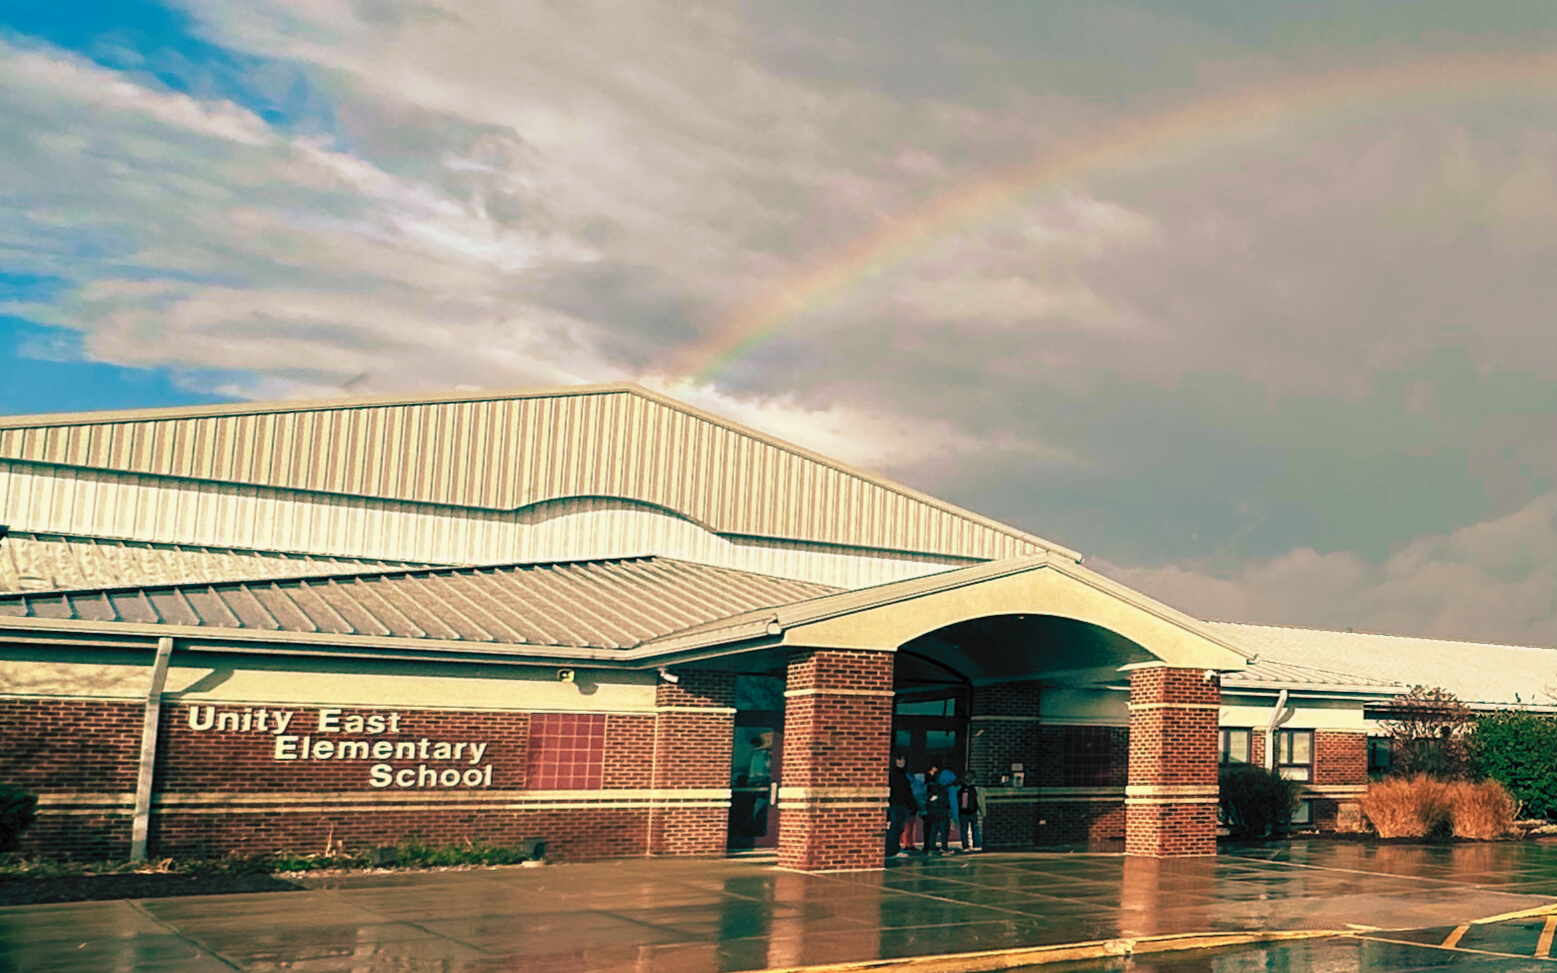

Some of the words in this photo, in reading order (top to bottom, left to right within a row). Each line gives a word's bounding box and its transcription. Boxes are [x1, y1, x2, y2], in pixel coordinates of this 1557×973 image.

[188, 705, 295, 736] Unity
[318, 708, 401, 734] East
[274, 735, 488, 765] Elementary
[369, 763, 493, 788] School
